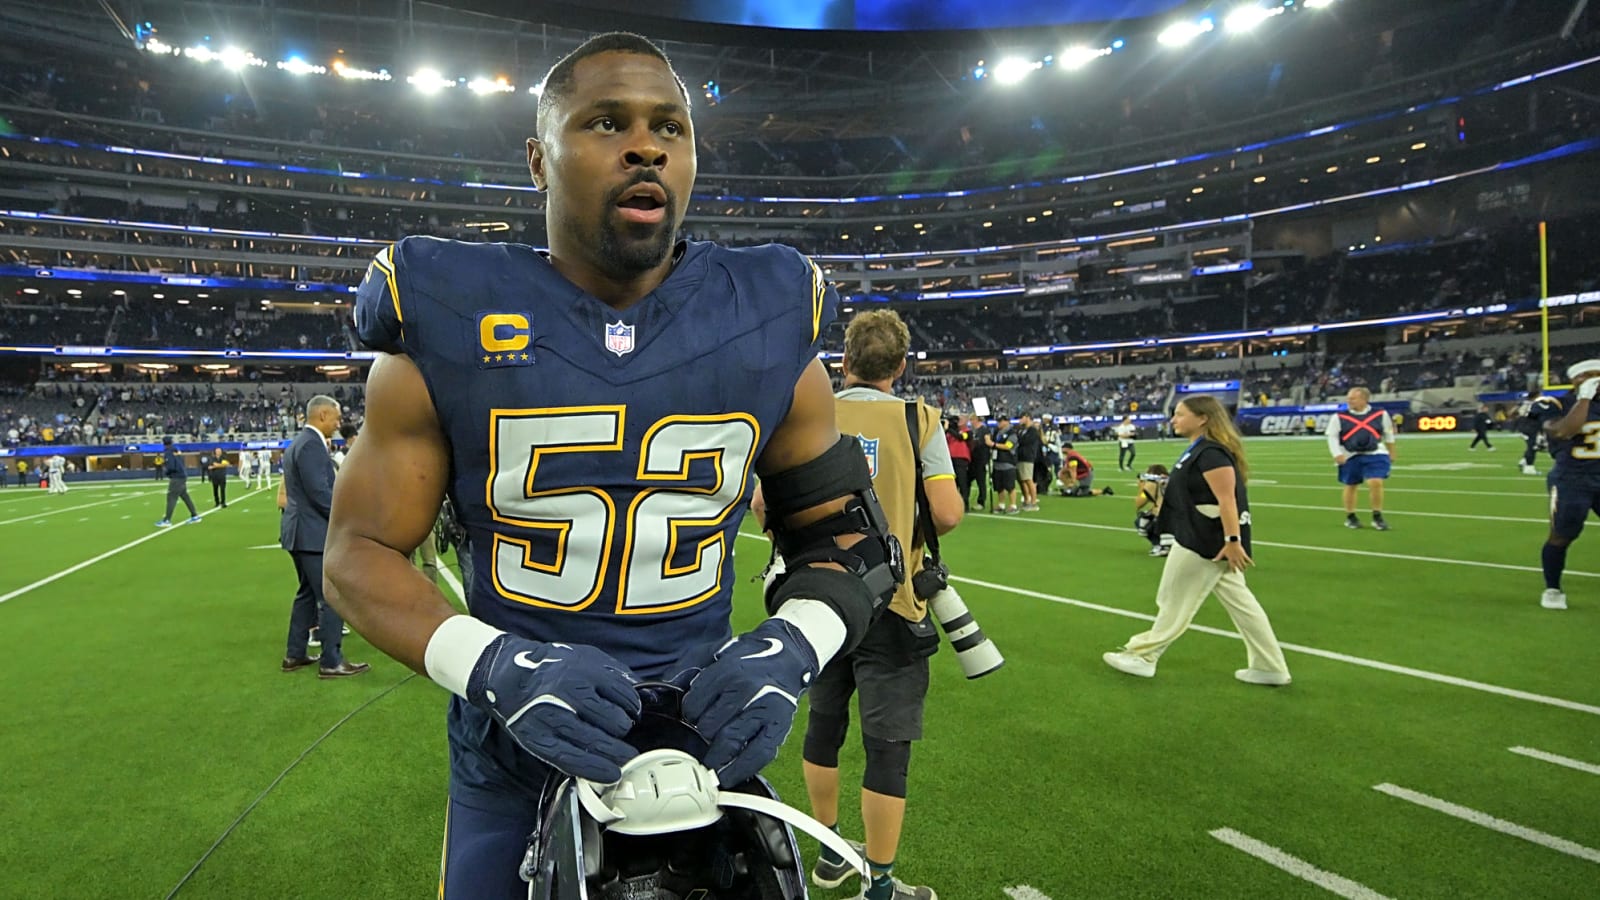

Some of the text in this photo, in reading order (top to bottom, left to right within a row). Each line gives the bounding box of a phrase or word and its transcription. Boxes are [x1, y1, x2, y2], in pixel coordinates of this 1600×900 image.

[479, 313, 529, 352] C
[610, 335, 629, 350] NFL
[1418, 416, 1457, 430] 0:00
[485, 404, 761, 615] 52
